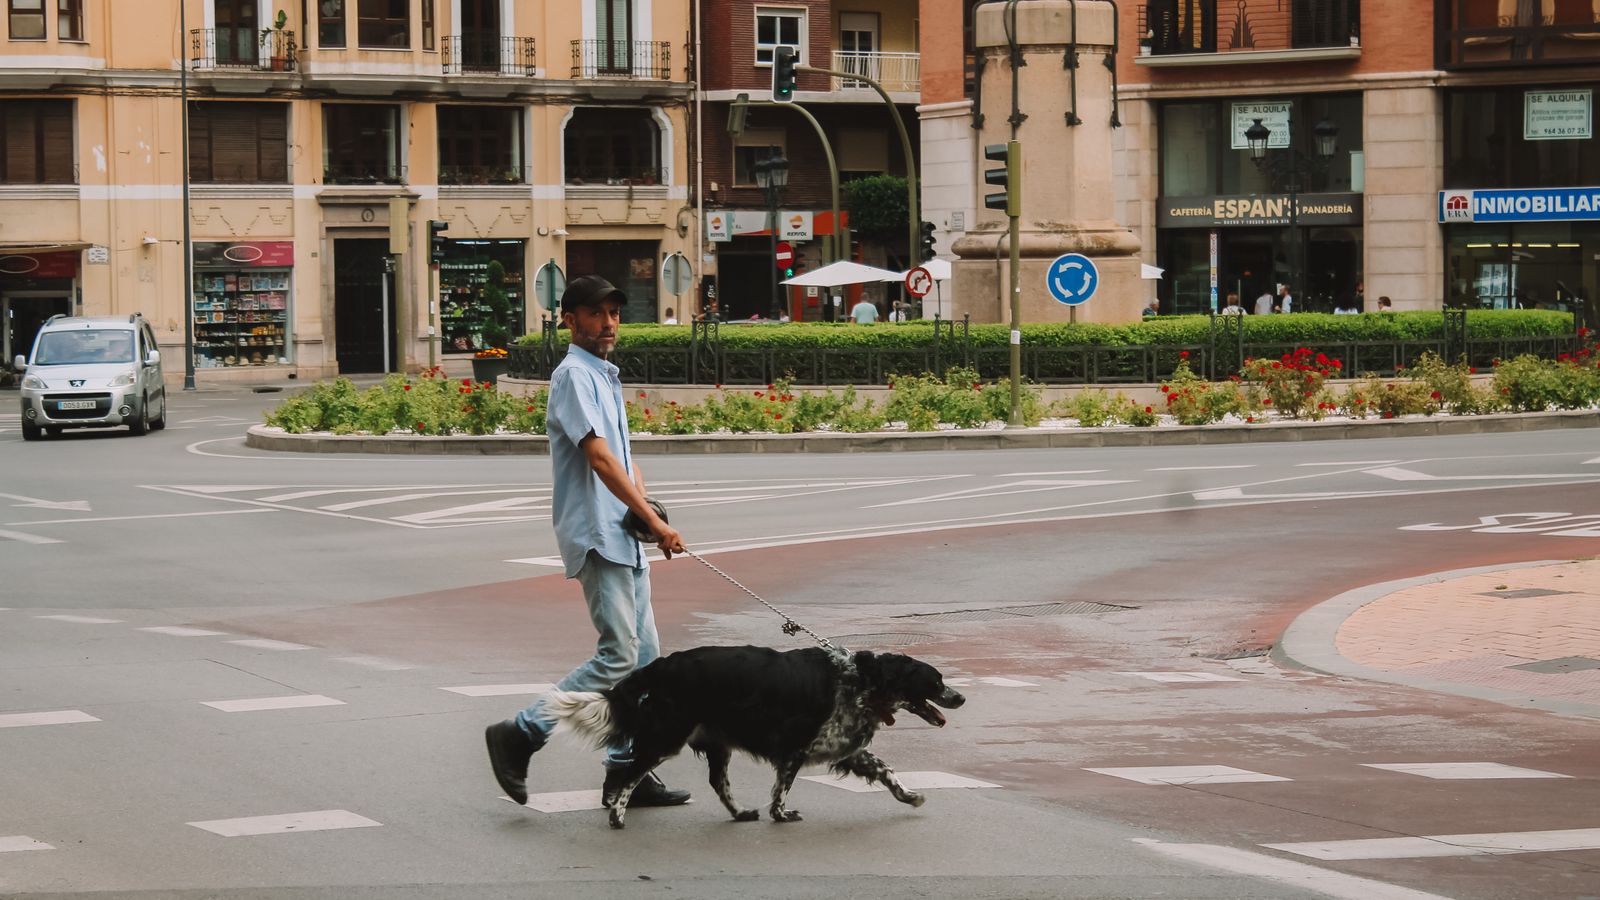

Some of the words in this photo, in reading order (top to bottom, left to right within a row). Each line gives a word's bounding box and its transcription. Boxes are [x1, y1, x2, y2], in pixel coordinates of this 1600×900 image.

[1531, 95, 1543, 103] SE
[1547, 94, 1586, 102] ALQUILA
[1238, 106, 1249, 114] SE
[1253, 105, 1287, 113] ALQUILA
[1170, 206, 1212, 216] CAFETERÍA
[1302, 204, 1353, 214] PANADERÍA
